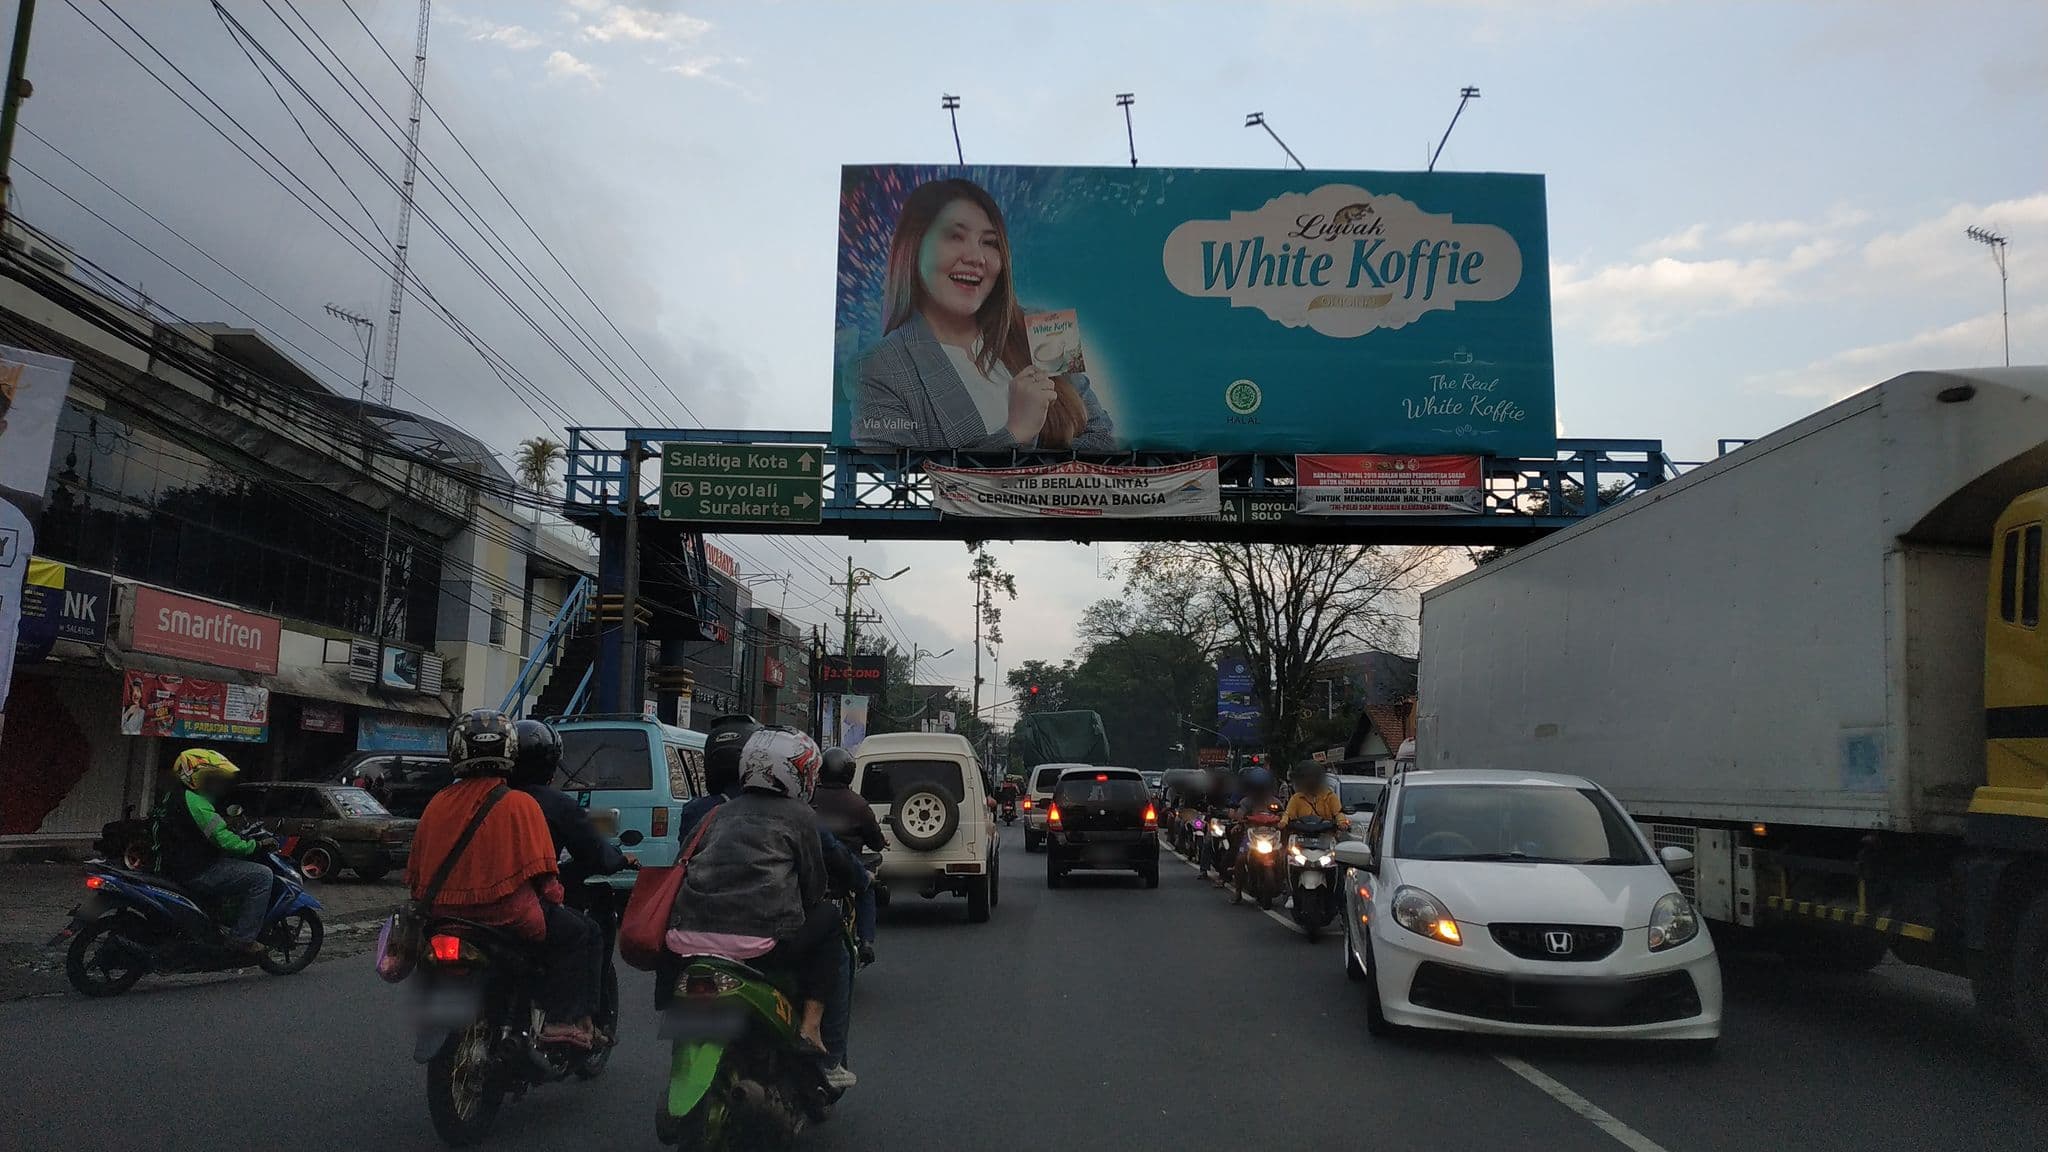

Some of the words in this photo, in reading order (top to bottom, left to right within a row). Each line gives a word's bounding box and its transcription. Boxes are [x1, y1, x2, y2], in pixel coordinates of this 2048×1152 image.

[1288, 214, 1385, 241] Luwak
[1201, 237, 1333, 290] White
[1346, 238, 1485, 300] Koffie
[1429, 374, 1457, 391] The
[1461, 372, 1501, 393] Real
[1402, 398, 1464, 421] White
[1470, 395, 1526, 424] Koffie
[863, 418, 881, 431] Via
[882, 418, 919, 431] Vallen
[1226, 415, 1261, 426] HALAL
[670, 451, 741, 472] Salatiga
[748, 453, 788, 469] Kota
[674, 483, 690, 496] 16
[700, 481, 778, 499] Boyolali
[1041, 477, 1101, 489] BERLALU
[1104, 477, 1149, 489] LINTAS
[977, 492, 1049, 506] CERMINAN
[1052, 494, 1109, 506] BUDAYA
[1111, 492, 1166, 506] BANGSA
[1444, 495, 1465, 503] ANDA
[699, 500, 791, 516] Surakarta
[1251, 503, 1296, 511] BOYOLA
[1251, 512, 1282, 521] SOLO
[158, 607, 262, 650] smartfren
